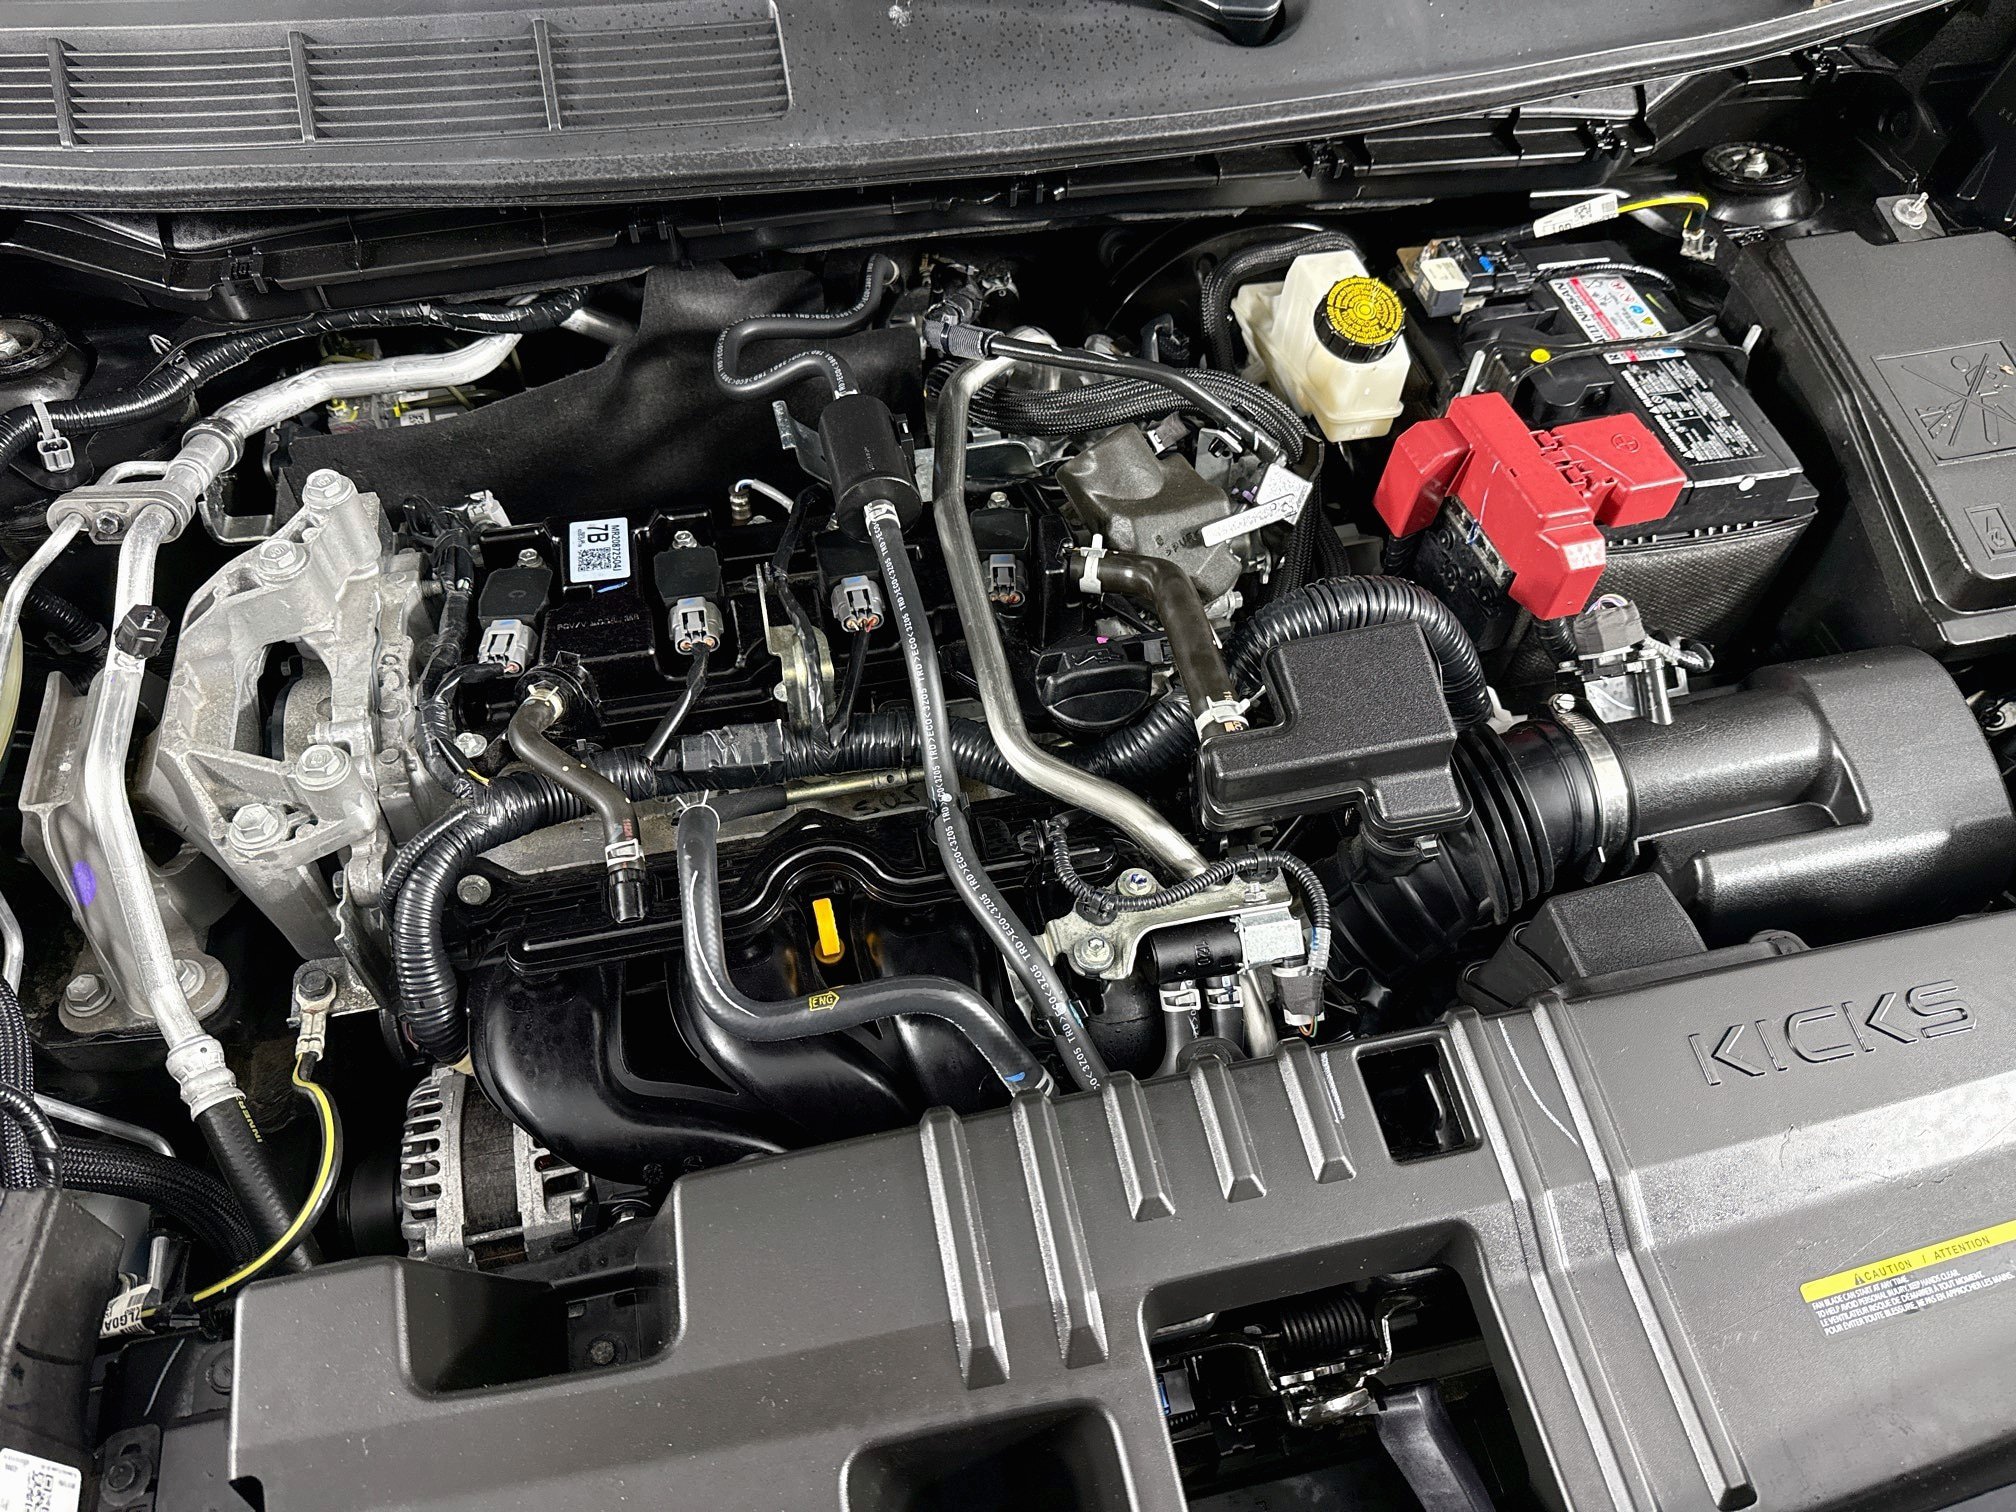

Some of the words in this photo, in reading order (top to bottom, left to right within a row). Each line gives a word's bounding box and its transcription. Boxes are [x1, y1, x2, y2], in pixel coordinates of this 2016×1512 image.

[586, 523, 609, 543] 7B
[812, 994, 834, 1008] ENG
[1688, 979, 1977, 1086] KICKS
[1864, 1259, 1912, 1281] CAUTION
[1934, 1235, 1991, 1260] ATTENTION
[1825, 1305, 1840, 1316] HELP
[1858, 1290, 1887, 1306] PERSONAL
[1890, 1296, 1901, 1306] DE
[1824, 1323, 1844, 1336] POUR
